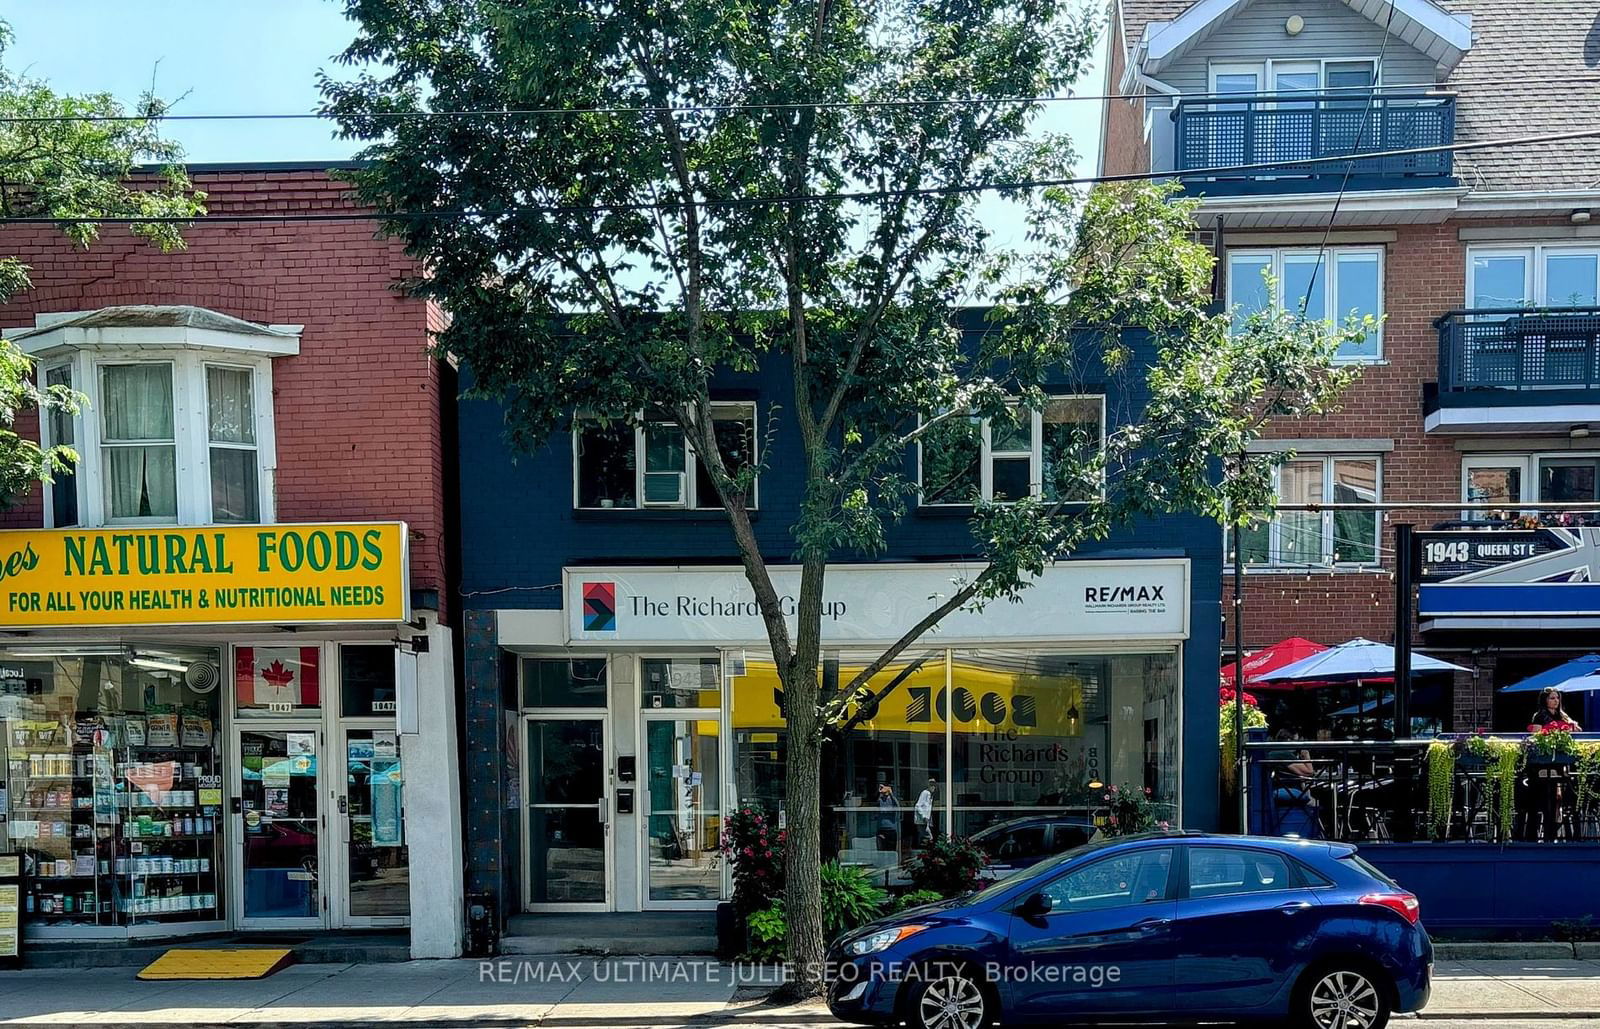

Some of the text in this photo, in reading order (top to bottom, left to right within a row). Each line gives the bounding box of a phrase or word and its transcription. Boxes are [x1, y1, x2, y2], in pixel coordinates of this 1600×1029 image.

[0, 530, 384, 582] es NATURAL FOODS
[1425, 541, 1536, 563] 1943 QUEEN ST E
[9, 585, 385, 612] FOR ALL YOUR HEALTH & NUTRITIONAL NEEDS
[1085, 585, 1164, 602] RE/MAX
[627, 595, 846, 621] The Richard Gup
[981, 743, 1068, 762] Richards
[198, 775, 221, 785] PROUD
[981, 765, 1043, 787] Group
